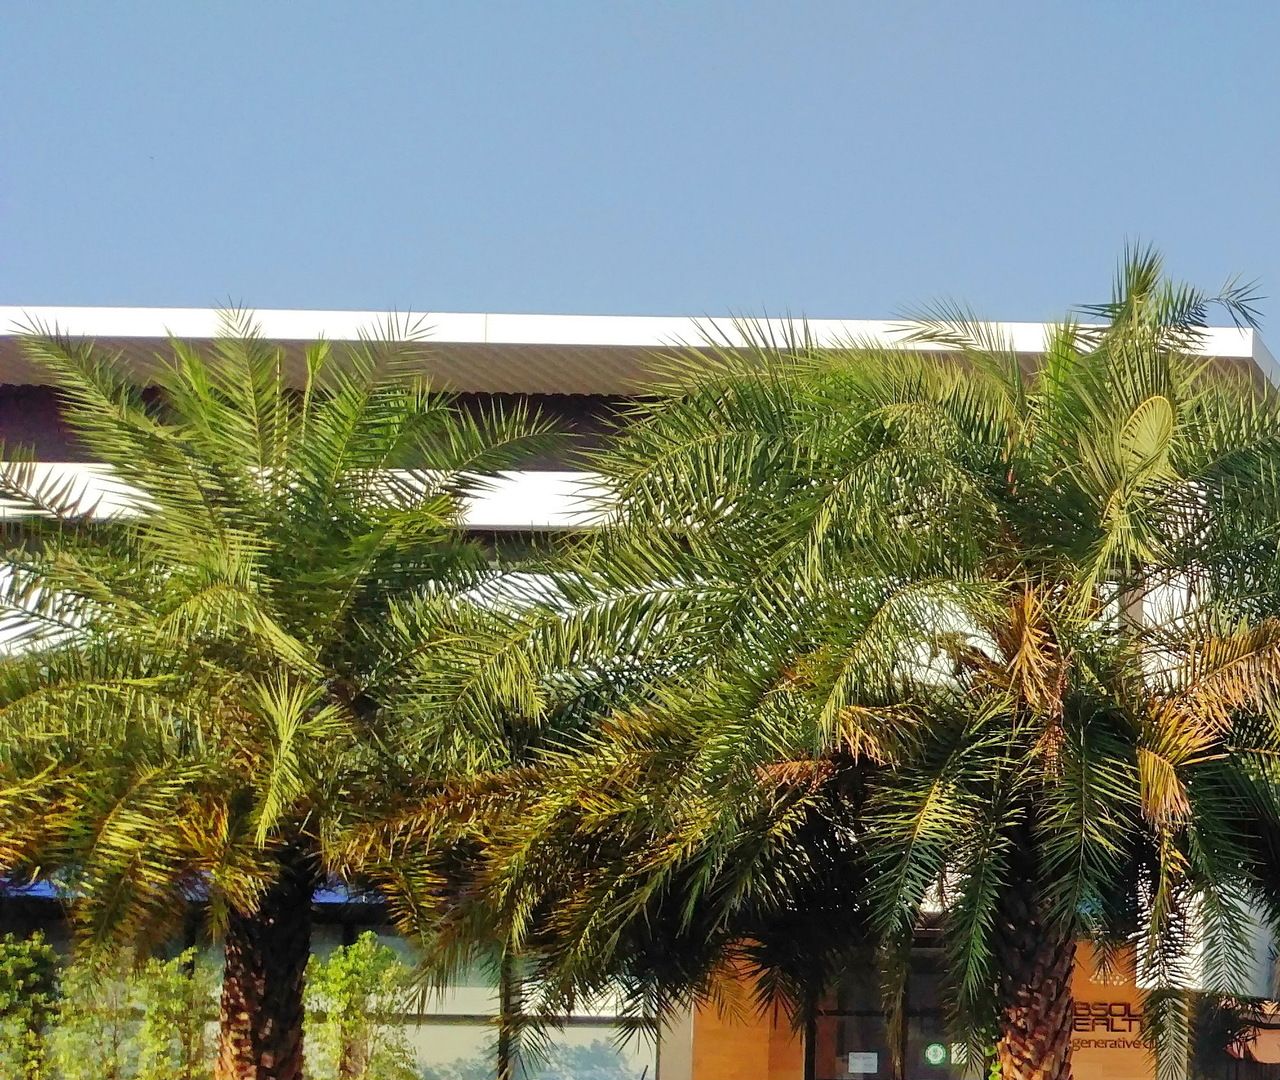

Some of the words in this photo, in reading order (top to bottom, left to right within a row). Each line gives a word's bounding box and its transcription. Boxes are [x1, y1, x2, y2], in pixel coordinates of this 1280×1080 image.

[1073, 1002, 1143, 1017] BSOL
[1073, 1017, 1143, 1032] EALT
[1072, 1038, 1141, 1051] generative
